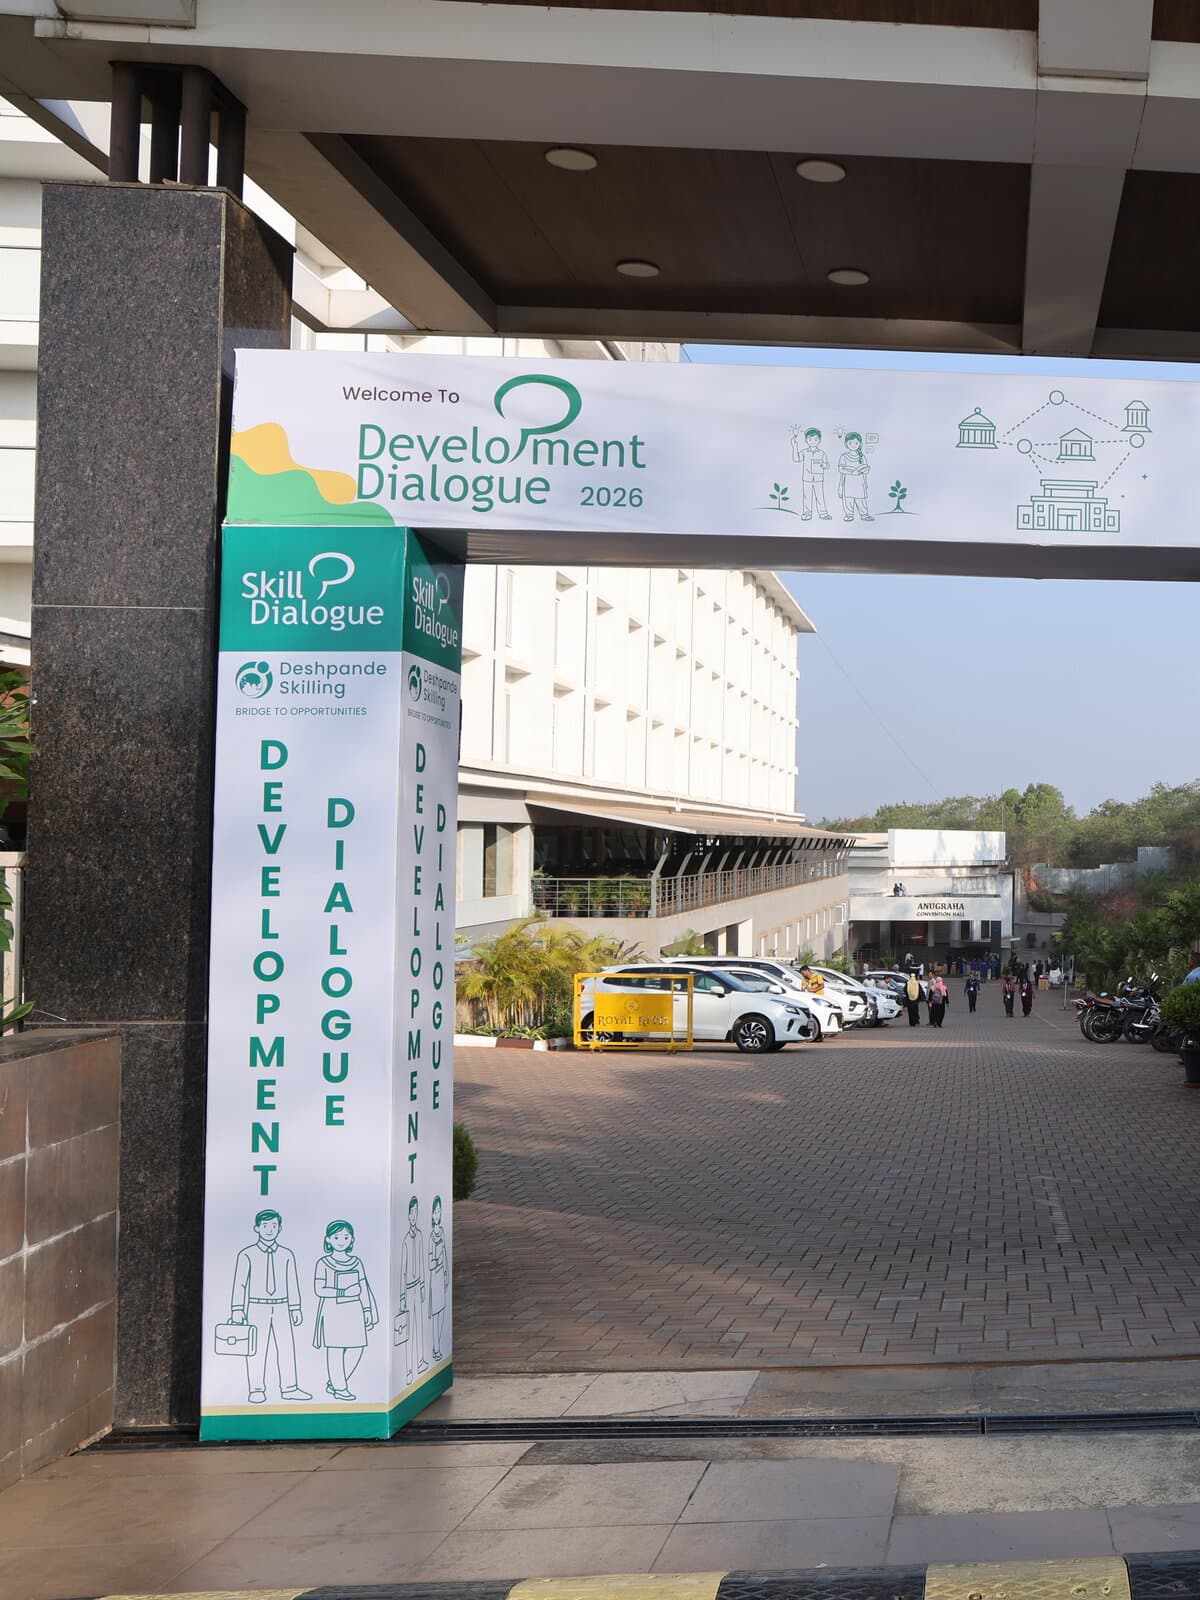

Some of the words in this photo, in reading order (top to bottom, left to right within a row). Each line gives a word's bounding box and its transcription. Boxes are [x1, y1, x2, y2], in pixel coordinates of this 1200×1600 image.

[342, 386, 433, 403] Welcome
[438, 388, 460, 404] To
[357, 463, 550, 513] Dialogue
[580, 487, 643, 507] 2026
[241, 570, 303, 599] Skill
[412, 576, 434, 611] Skill
[251, 599, 384, 632] Dialogue
[415, 605, 458, 648] Dialogue
[280, 661, 387, 679] Deshpande
[423, 669, 458, 695] Deshpande
[279, 681, 345, 698] Skilling
[235, 707, 272, 716] BRIDGE
[275, 707, 288, 716] TO
[290, 707, 367, 716] OPPORTUNITIES
[249, 740, 289, 1195] DEVELOPMENT
[321, 798, 355, 1126] DIALOGUE
[407, 743, 426, 1184] DEVELOPMENT
[432, 803, 446, 1110] DIALOGUE
